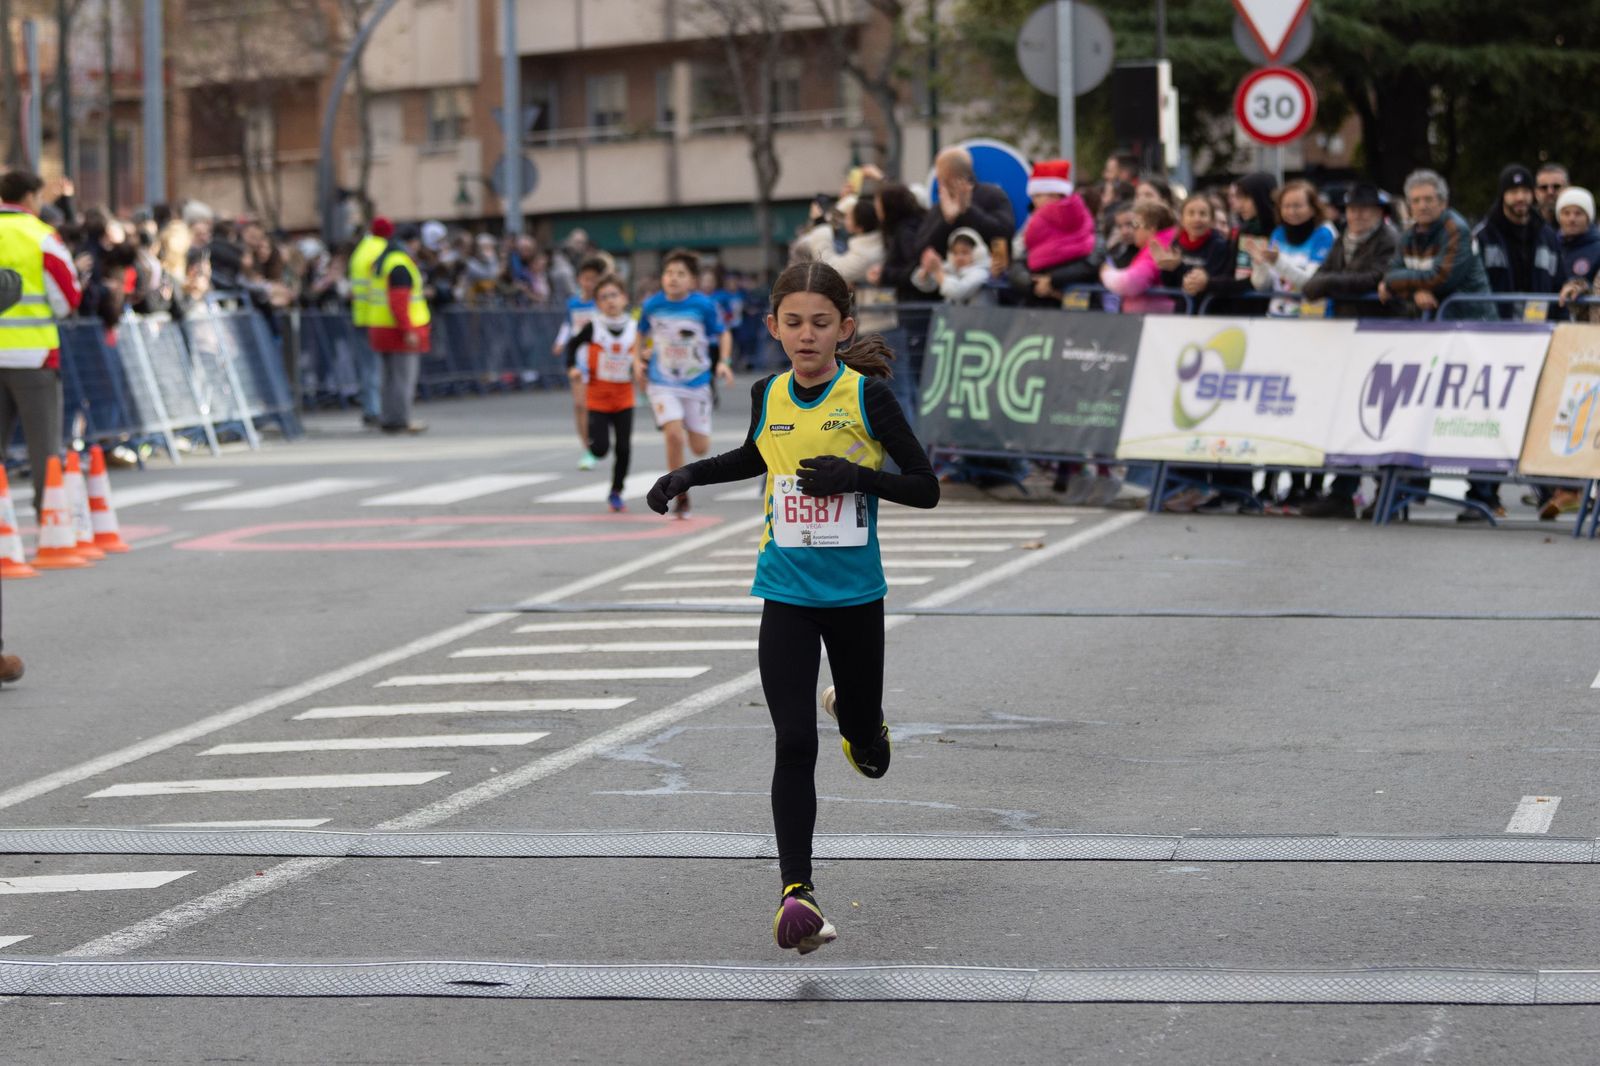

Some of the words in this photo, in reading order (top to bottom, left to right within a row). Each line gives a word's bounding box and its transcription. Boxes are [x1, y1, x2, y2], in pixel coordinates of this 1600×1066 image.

[1253, 94, 1296, 120] 30
[920, 320, 1055, 424] JRG
[1195, 373, 1297, 401] SETEL
[1432, 416, 1501, 438] fertilizantes
[784, 495, 844, 523] 6587
